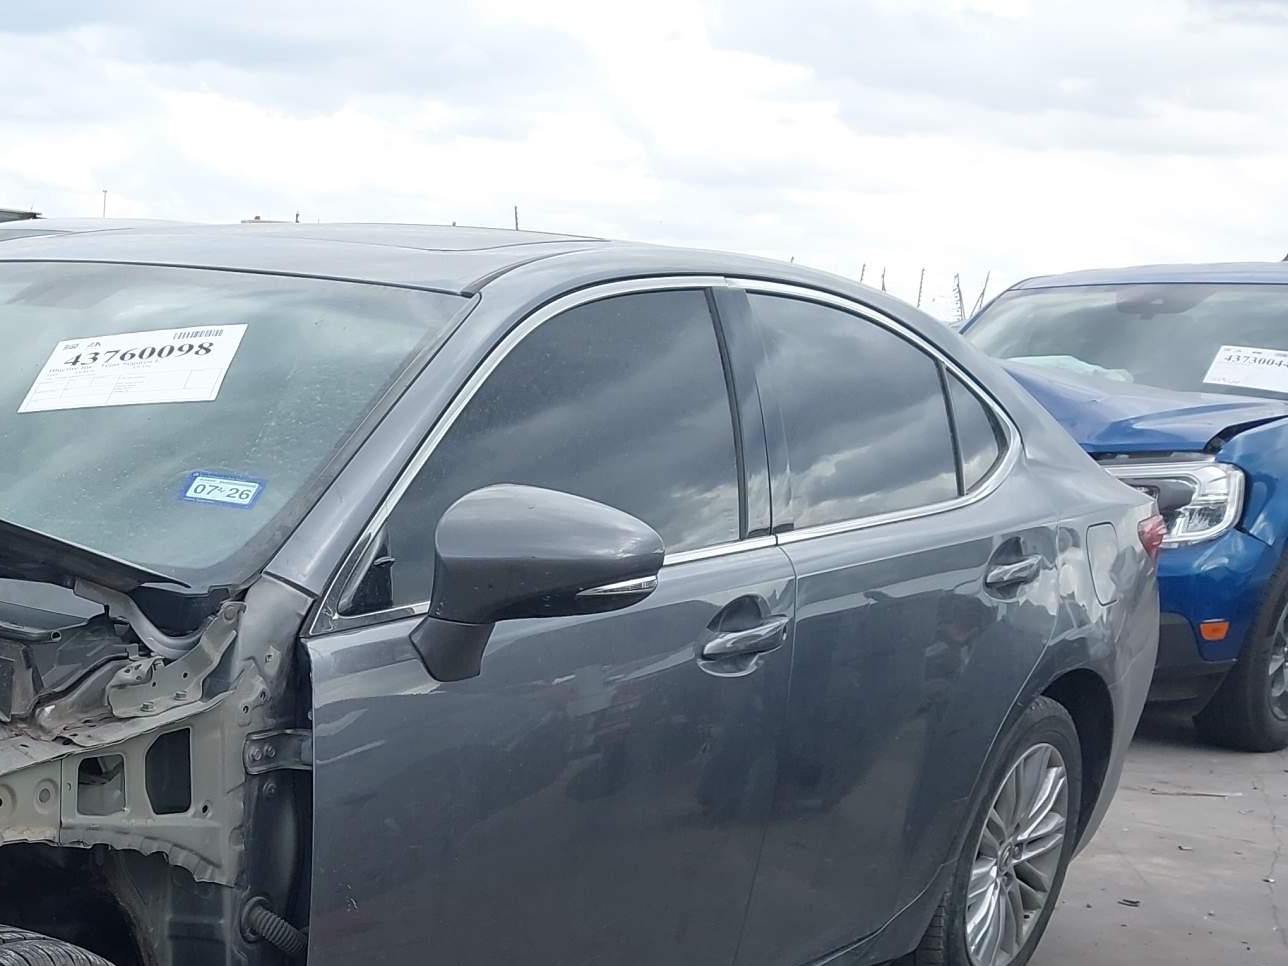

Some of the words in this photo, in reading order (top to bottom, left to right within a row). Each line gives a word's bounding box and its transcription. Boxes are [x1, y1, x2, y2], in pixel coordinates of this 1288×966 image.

[63, 341, 215, 367] 43760098
[193, 483, 220, 496] 07
[225, 487, 253, 501] 26
